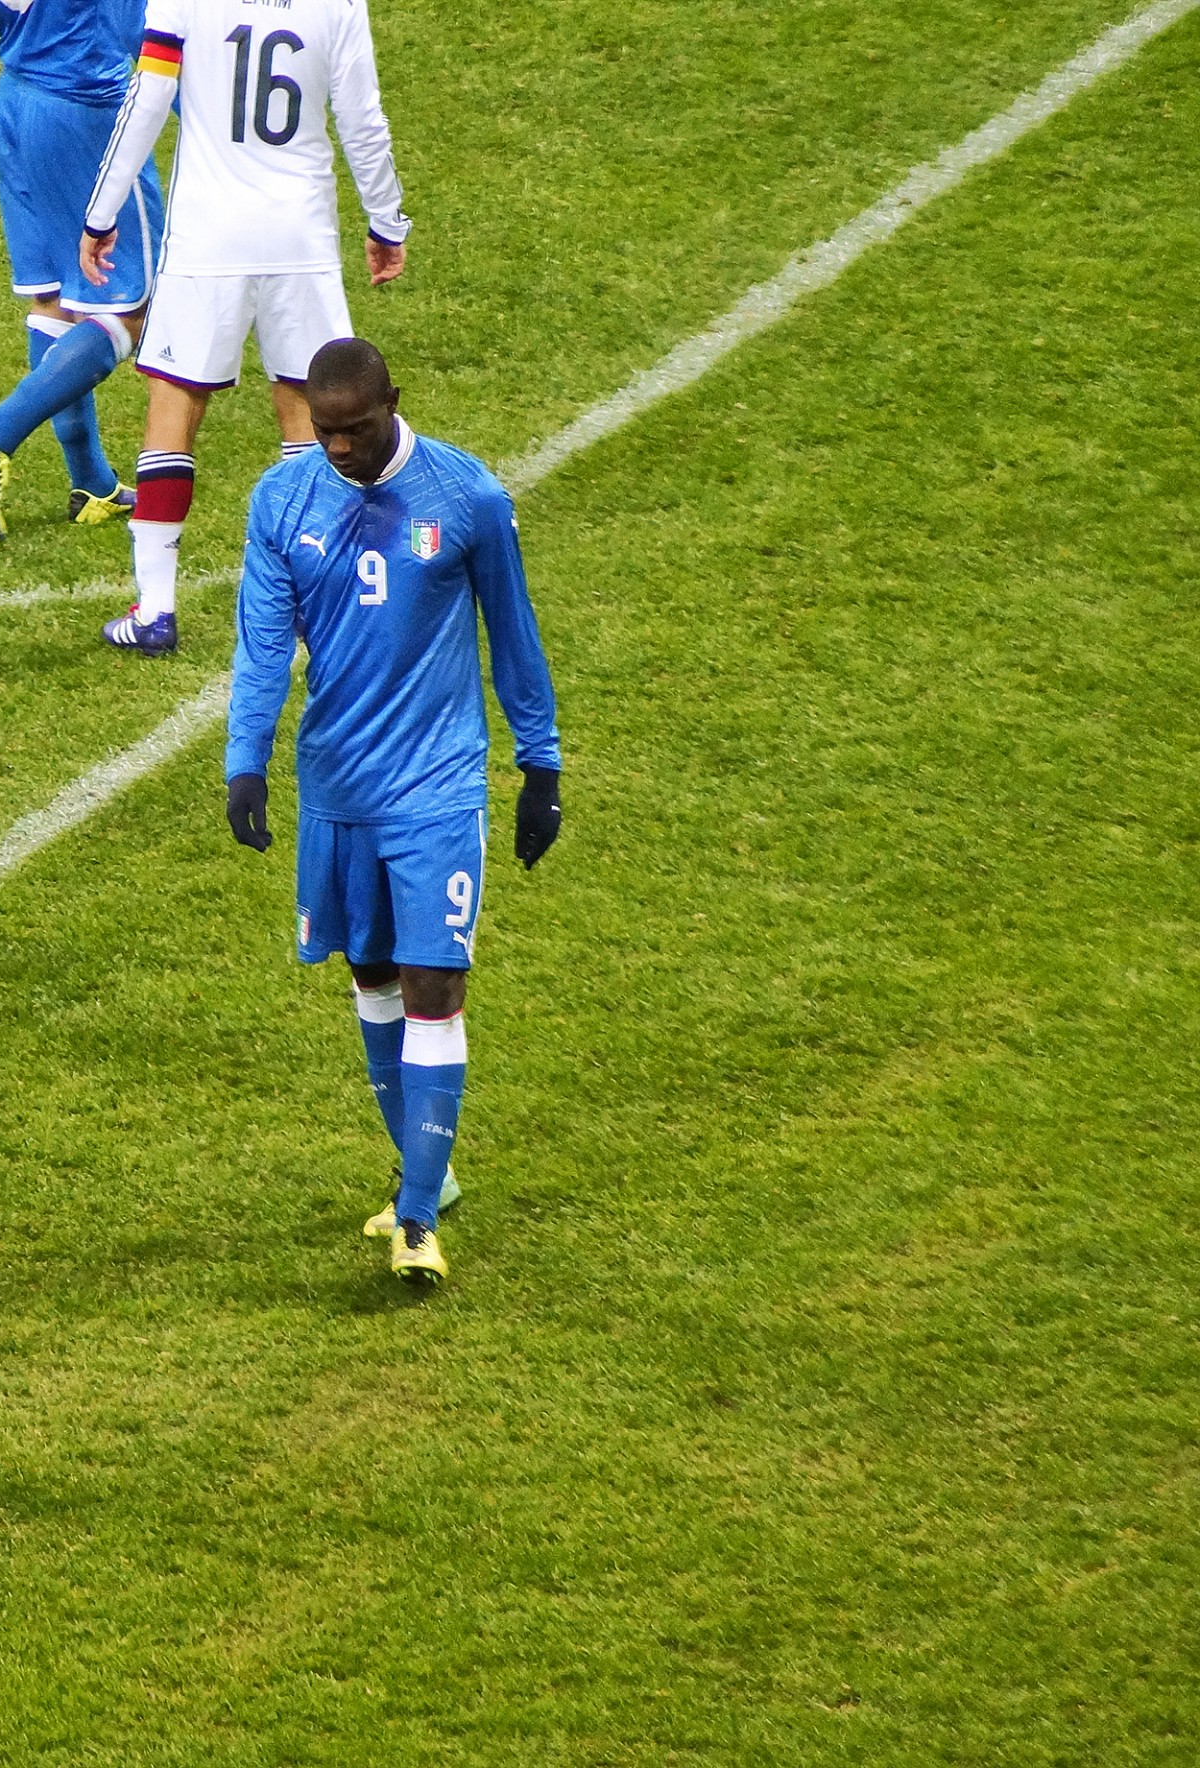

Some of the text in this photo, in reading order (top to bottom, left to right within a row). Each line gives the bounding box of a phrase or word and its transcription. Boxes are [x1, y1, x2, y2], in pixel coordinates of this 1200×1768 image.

[224, 24, 305, 146] 16
[357, 551, 387, 605] 9
[445, 871, 474, 928] 9
[421, 1123, 454, 1139] ITALIA
